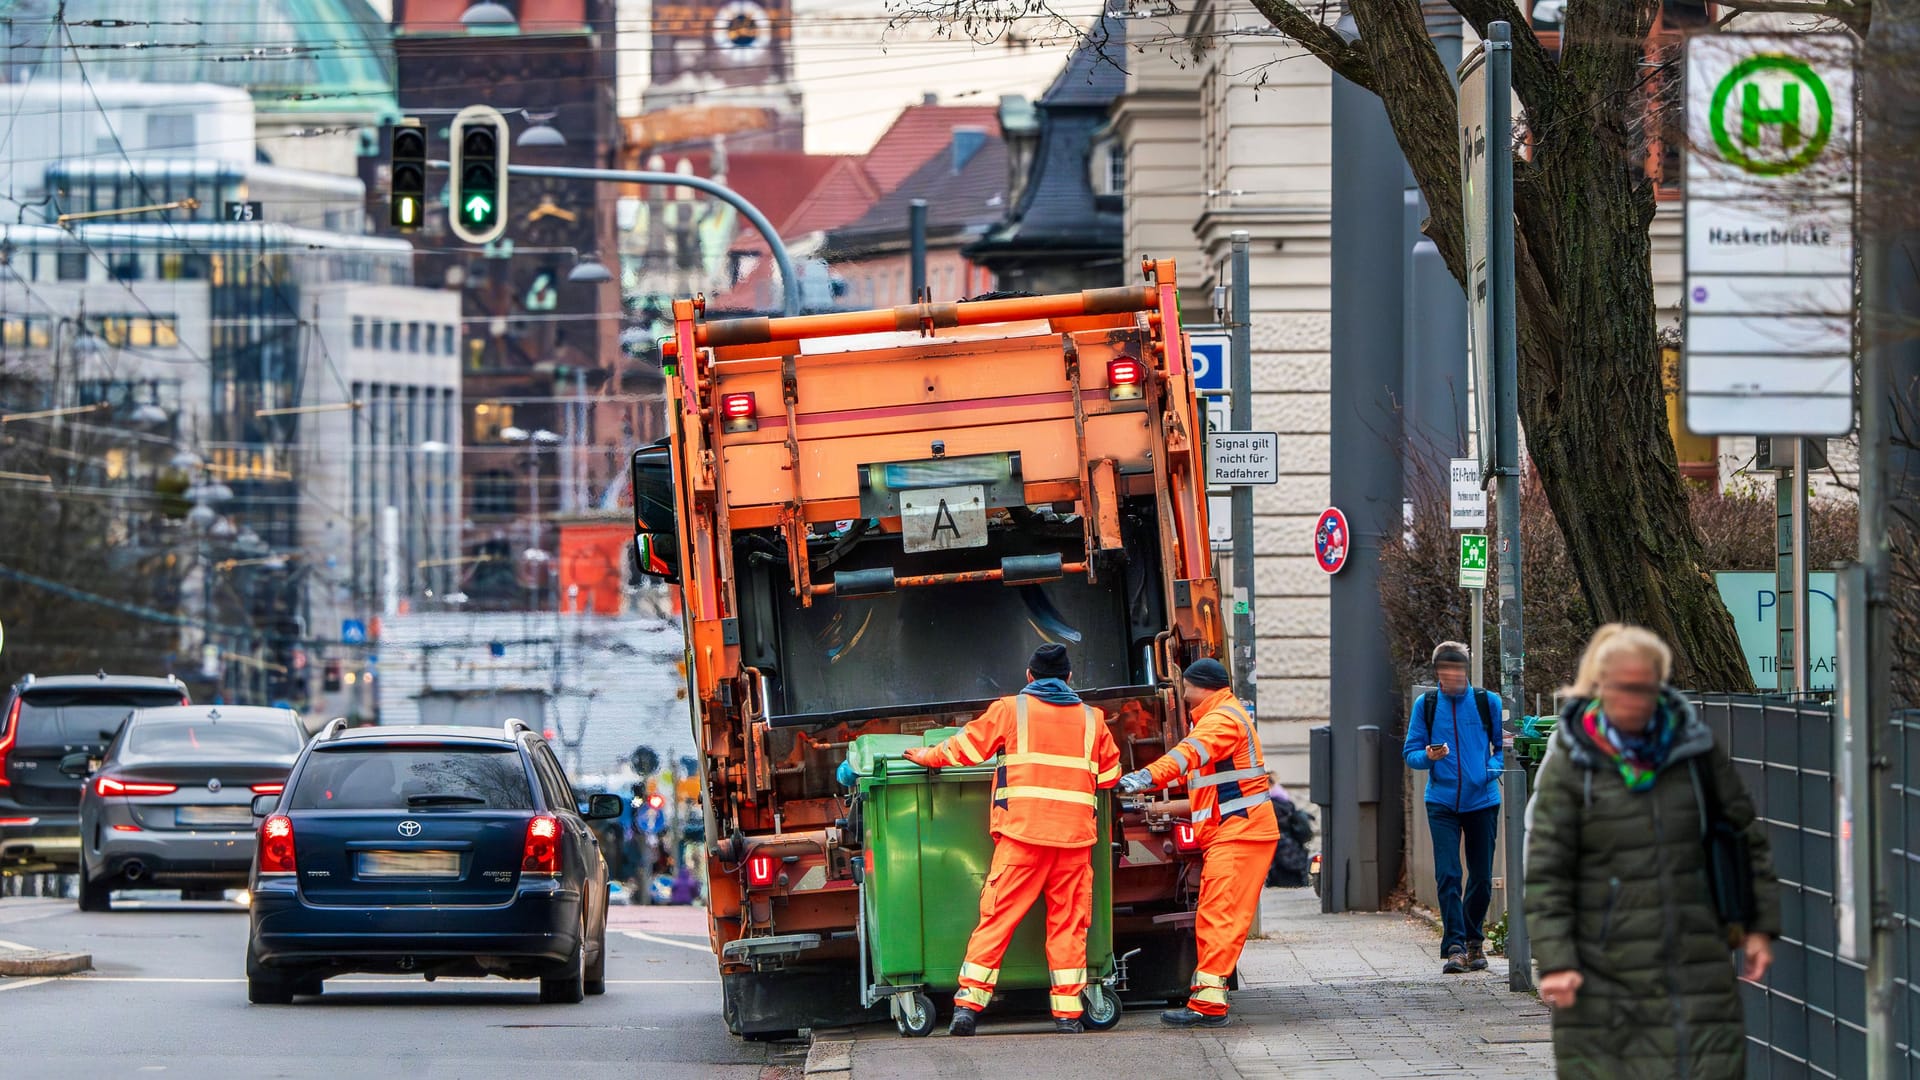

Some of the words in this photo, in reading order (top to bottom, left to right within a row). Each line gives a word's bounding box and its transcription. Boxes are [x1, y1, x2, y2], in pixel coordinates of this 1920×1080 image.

[1742, 83, 1799, 147] H
[233, 204, 254, 221] 75
[1215, 438, 1249, 451] Signal
[1252, 438, 1269, 451] gilt
[1220, 453, 1246, 463] nicht
[1249, 453, 1265, 463] für
[1215, 468, 1269, 478] Radfahrer
[931, 498, 961, 541] A
